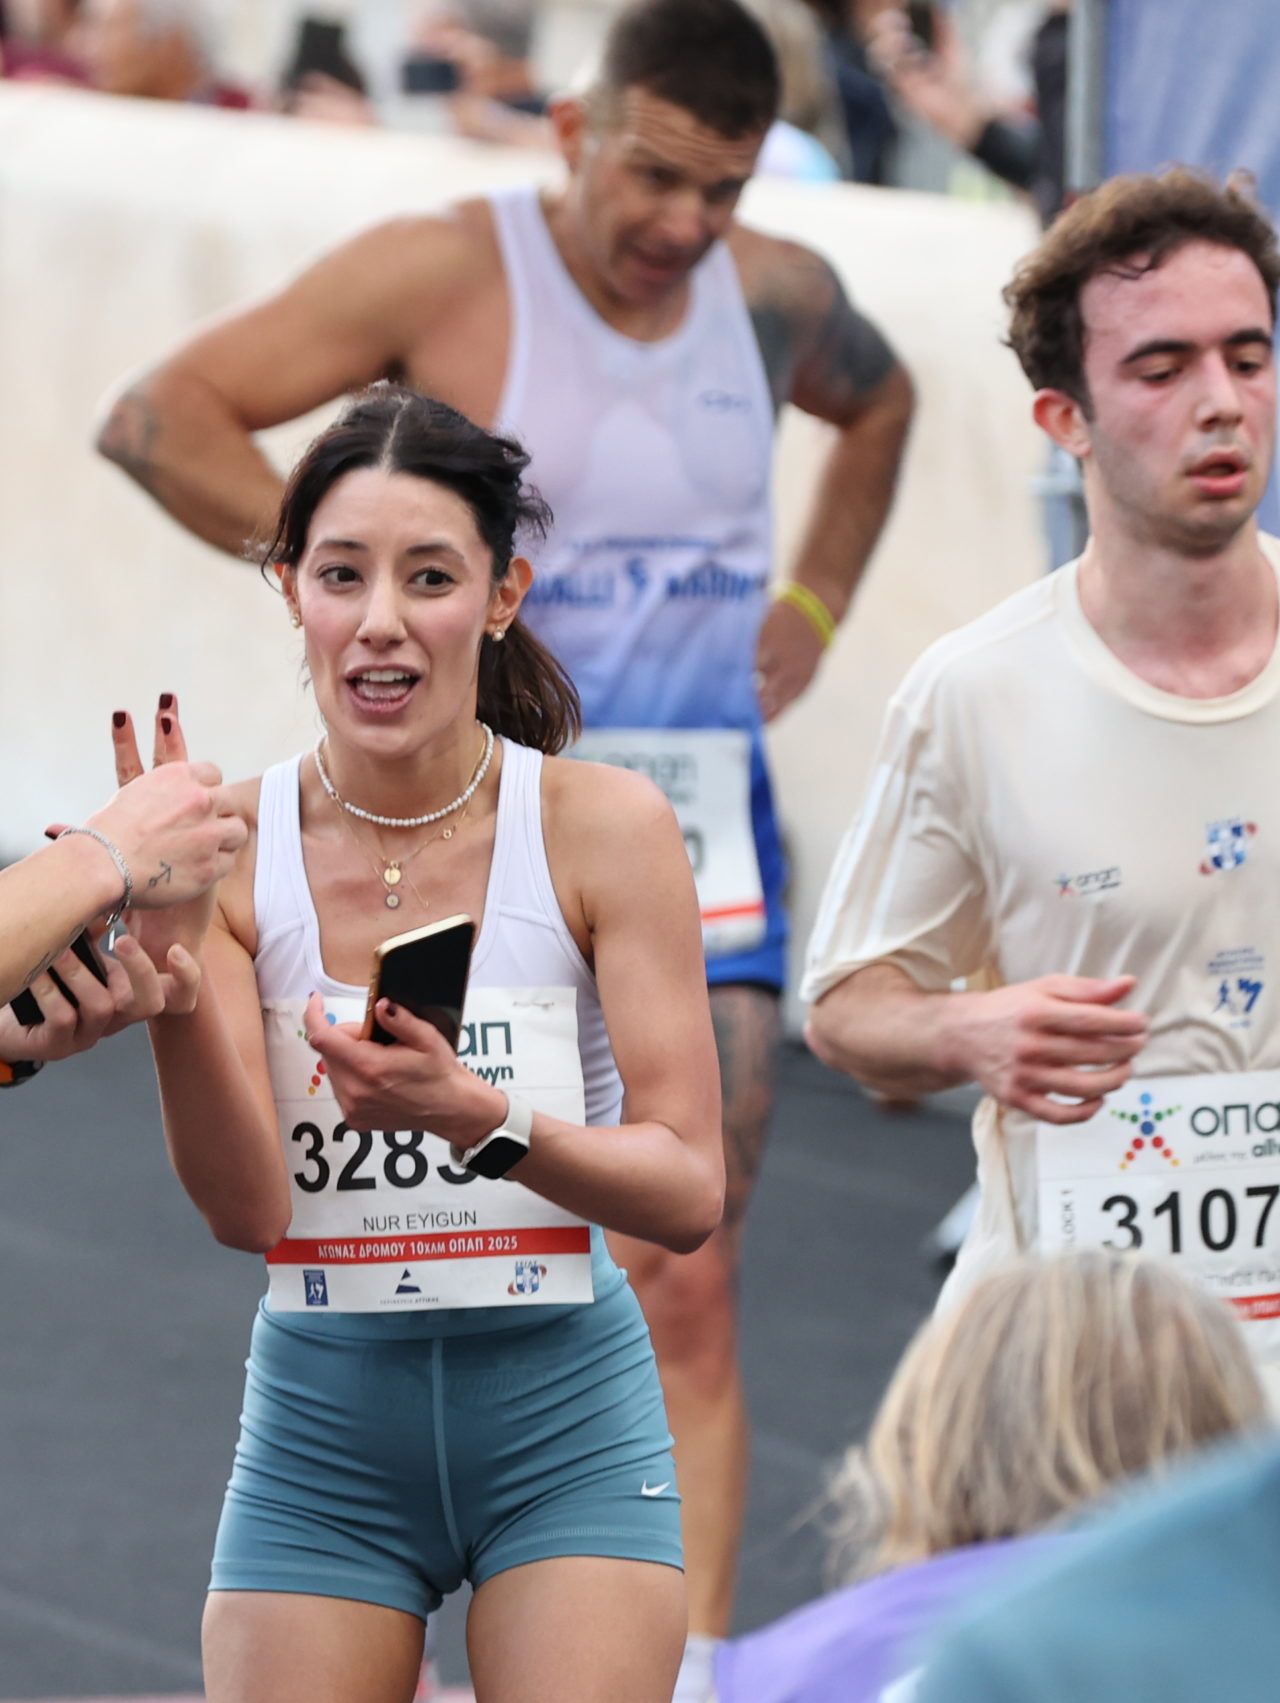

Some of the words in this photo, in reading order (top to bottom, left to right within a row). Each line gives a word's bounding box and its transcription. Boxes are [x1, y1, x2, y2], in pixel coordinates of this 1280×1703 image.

[463, 1061, 514, 1087] wyn
[291, 1121, 519, 1193] 328
[363, 1214, 400, 1232] NUR
[406, 1210, 477, 1230] EYIGUN
[1061, 1202, 1076, 1250] LOCK
[1101, 1185, 1280, 1254] 3107
[318, 1242, 356, 1260] ΑΓΩΝΑΣ
[359, 1242, 406, 1258] ΔΡΟΜΟΥ
[449, 1236, 484, 1253] ΟΠΑΠ
[488, 1235, 518, 1251] 2025
